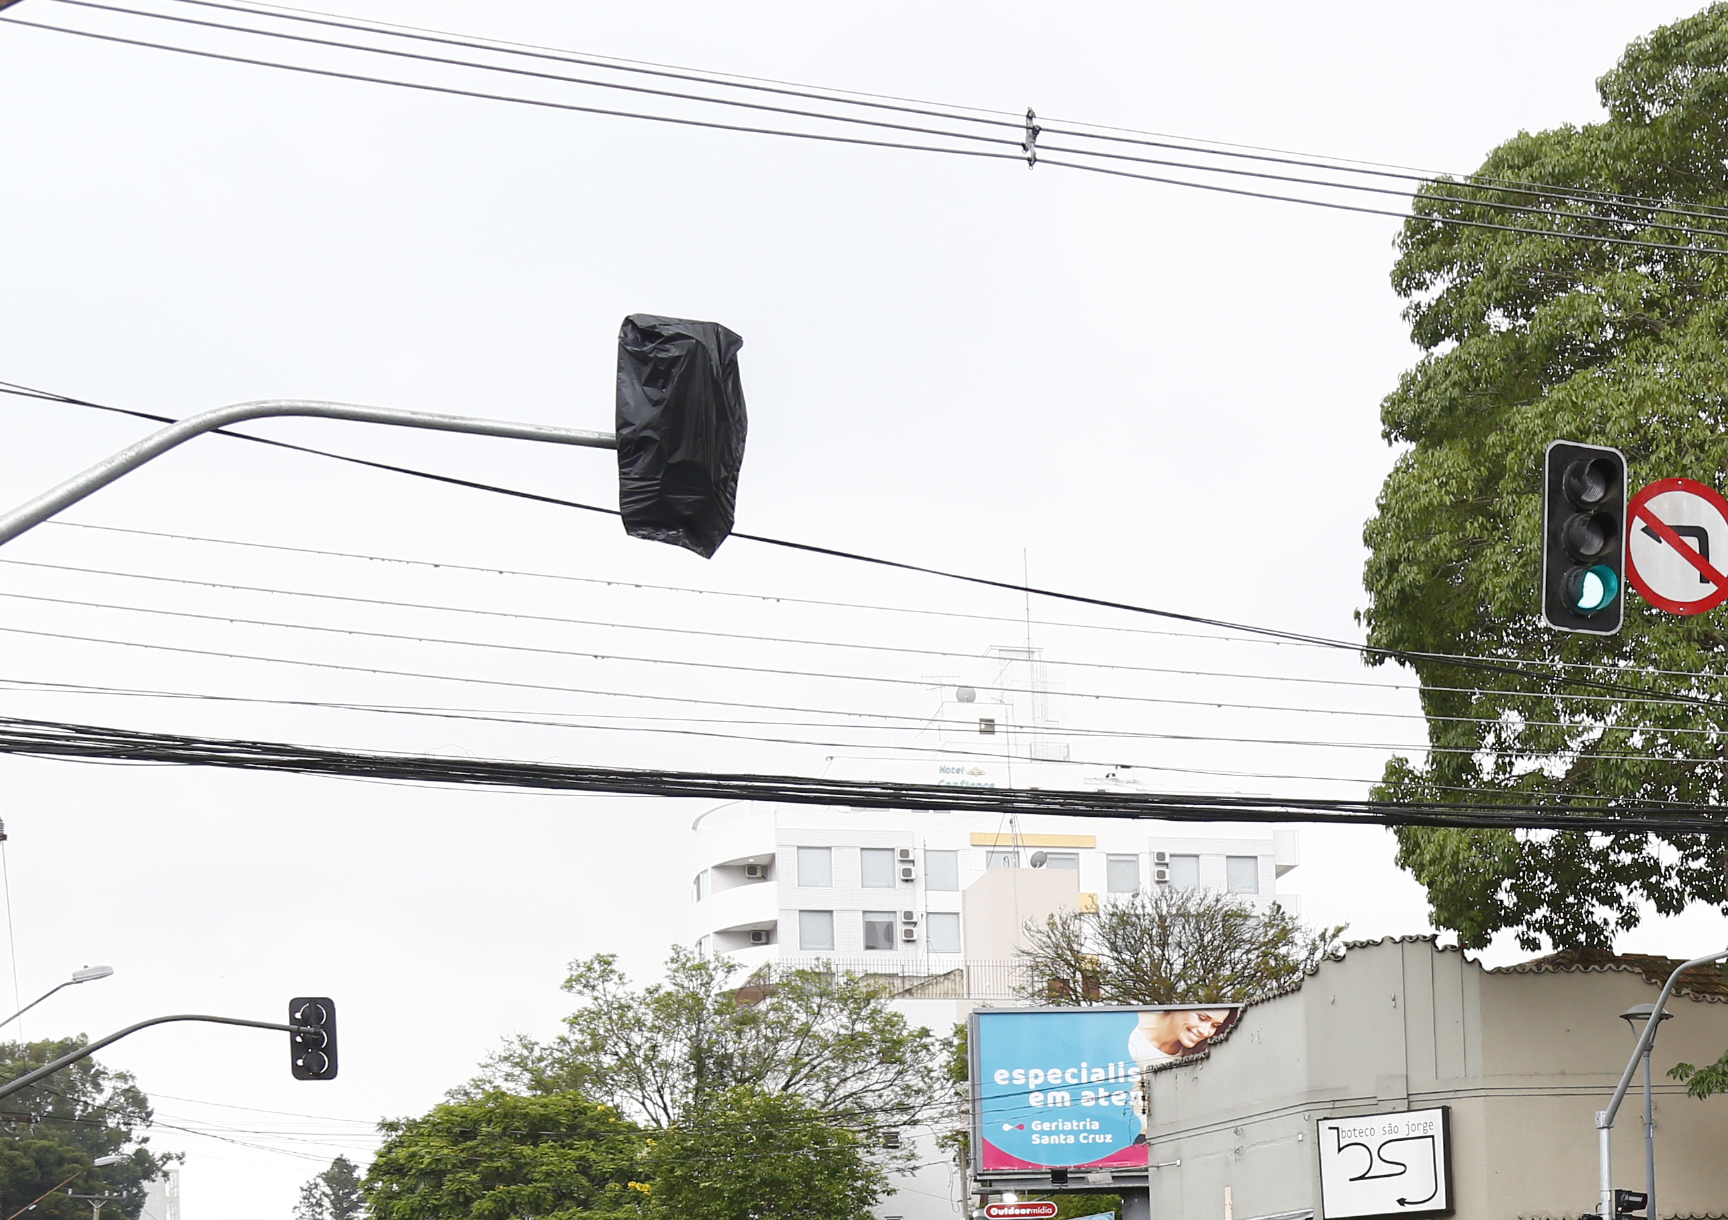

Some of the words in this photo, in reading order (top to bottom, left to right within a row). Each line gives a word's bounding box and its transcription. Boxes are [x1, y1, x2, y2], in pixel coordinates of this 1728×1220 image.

[1029, 1090, 1071, 1107] em
[1080, 1087, 1144, 1107] aten
[1031, 1118, 1100, 1131] Geriatria
[1341, 1126, 1375, 1139] boteco
[1381, 1122, 1399, 1136] são
[1405, 1120, 1435, 1137] jorge
[1031, 1133, 1075, 1144] Santa
[1079, 1133, 1113, 1143] Cruz
